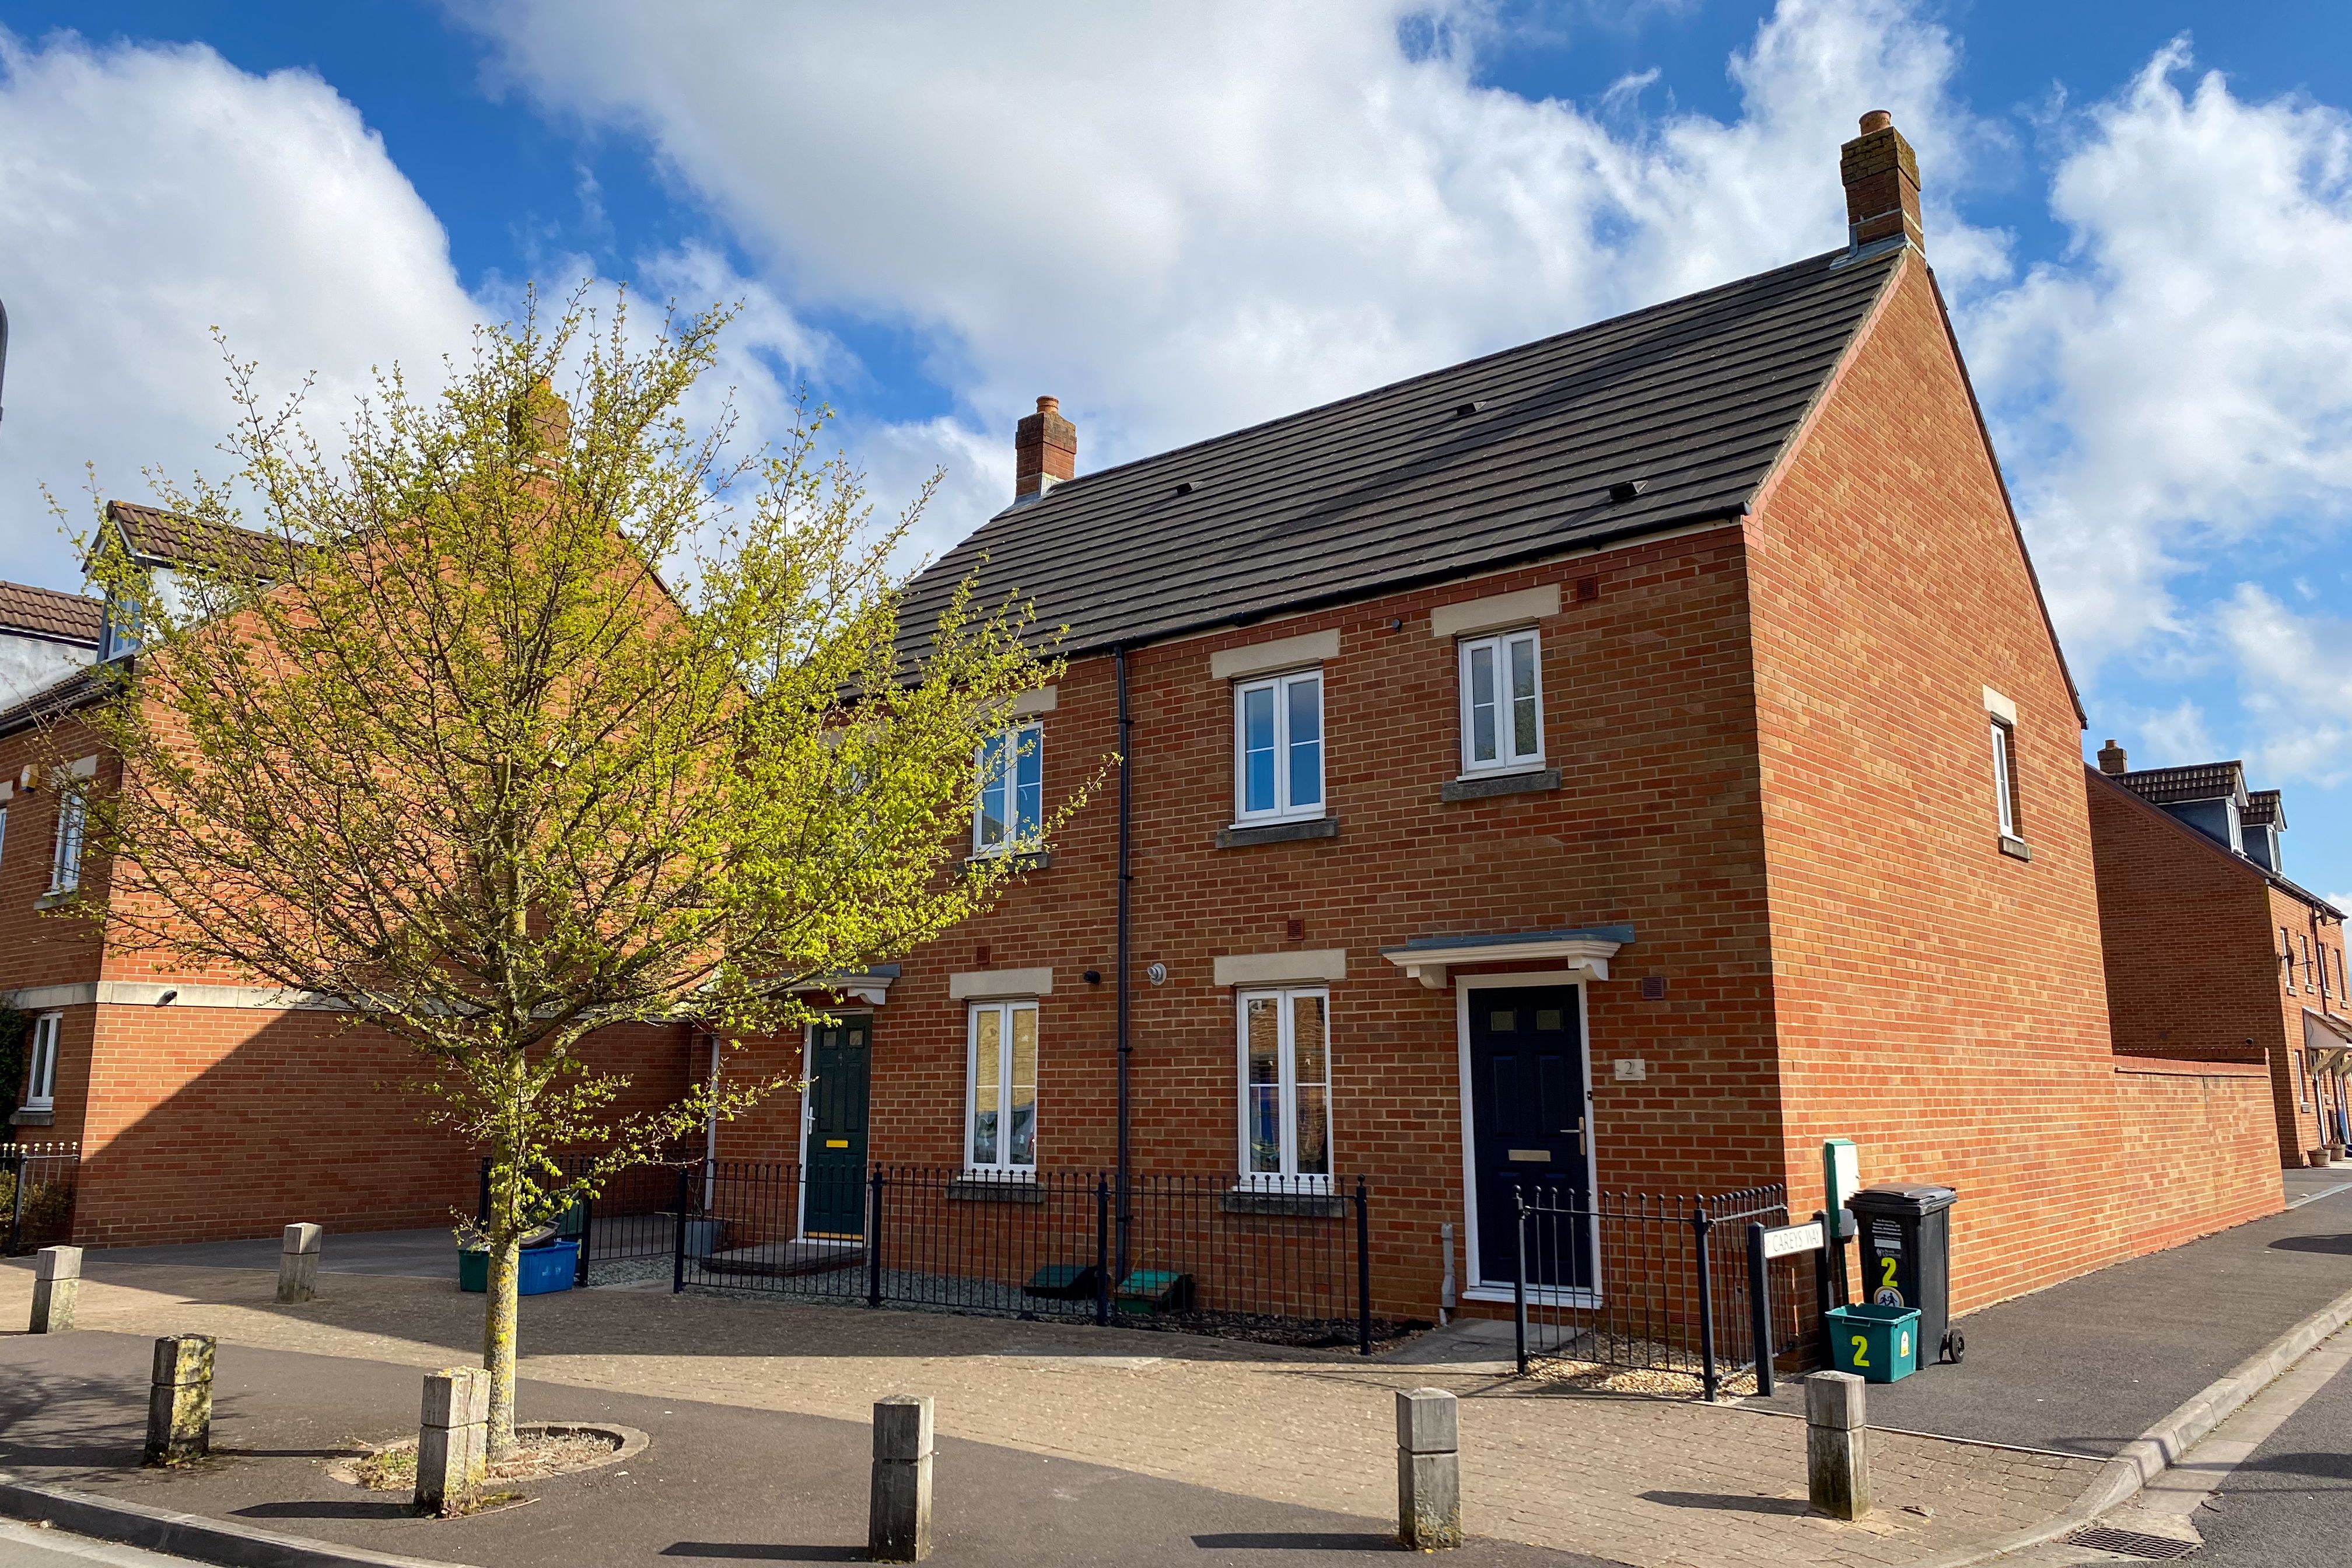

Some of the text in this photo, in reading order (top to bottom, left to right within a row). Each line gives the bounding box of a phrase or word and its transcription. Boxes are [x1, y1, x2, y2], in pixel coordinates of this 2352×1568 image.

[838, 1052, 843, 1060] 4
[1625, 1060, 1633, 1074] 2
[1773, 1227, 1820, 1252] CAREYS WAY
[1881, 1257, 1898, 1287] 2
[1852, 1335, 1870, 1367] 2
